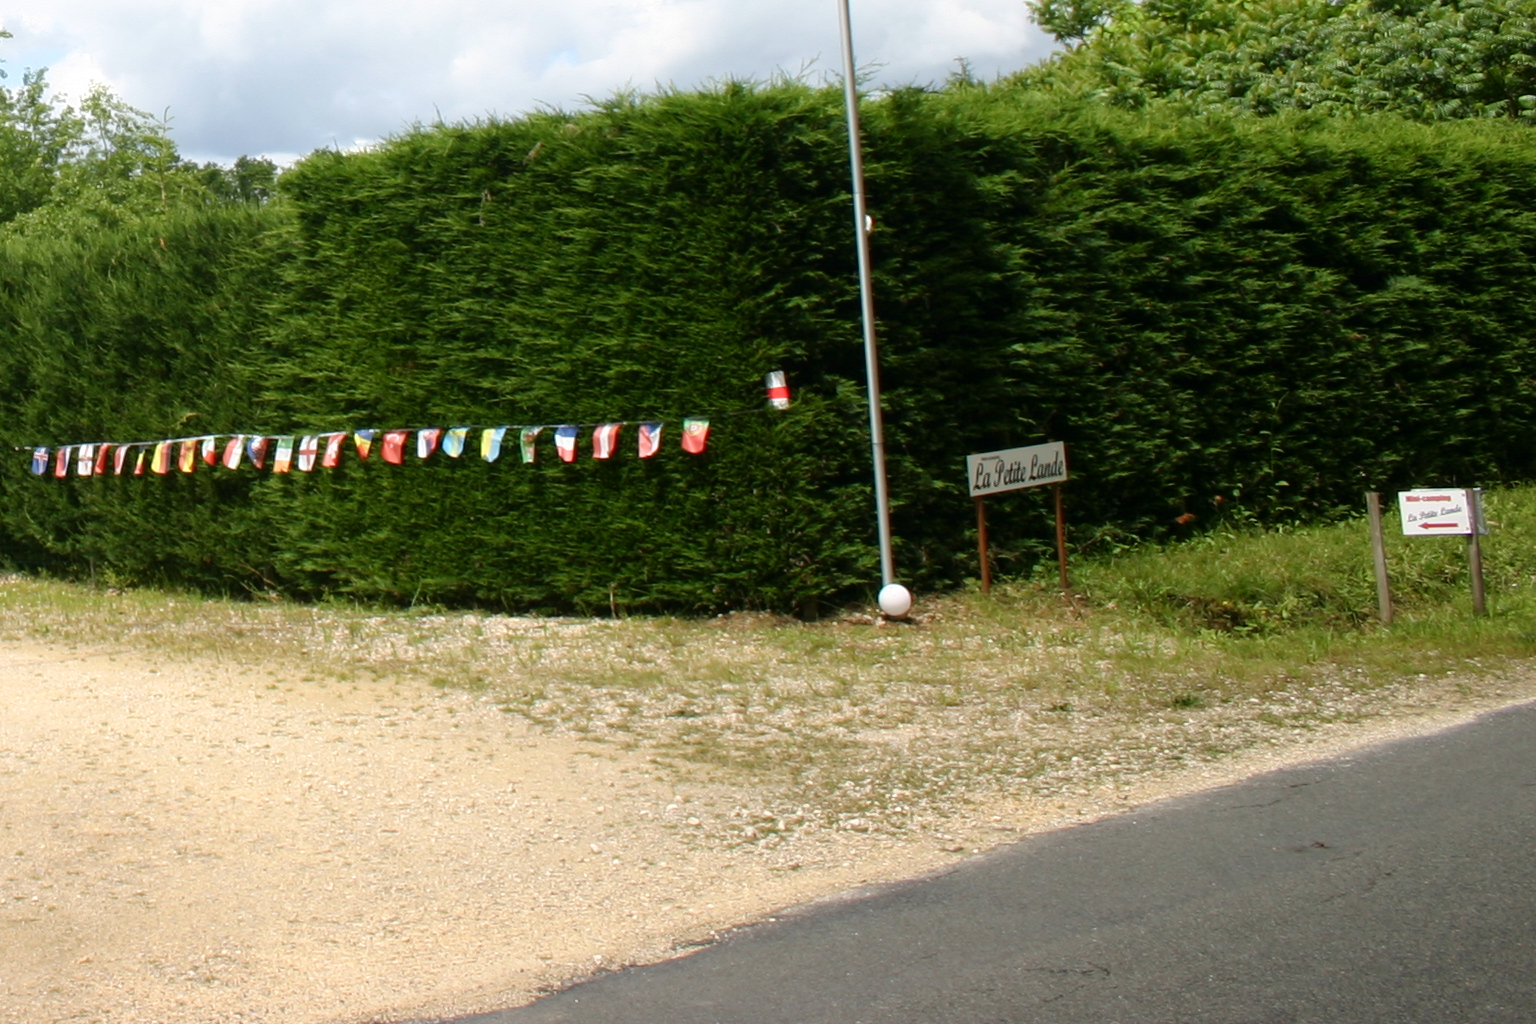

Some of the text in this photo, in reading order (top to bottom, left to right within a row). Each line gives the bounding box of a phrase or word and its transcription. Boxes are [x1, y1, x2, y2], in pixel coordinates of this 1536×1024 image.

[973, 450, 1064, 489] La Petite Lande
